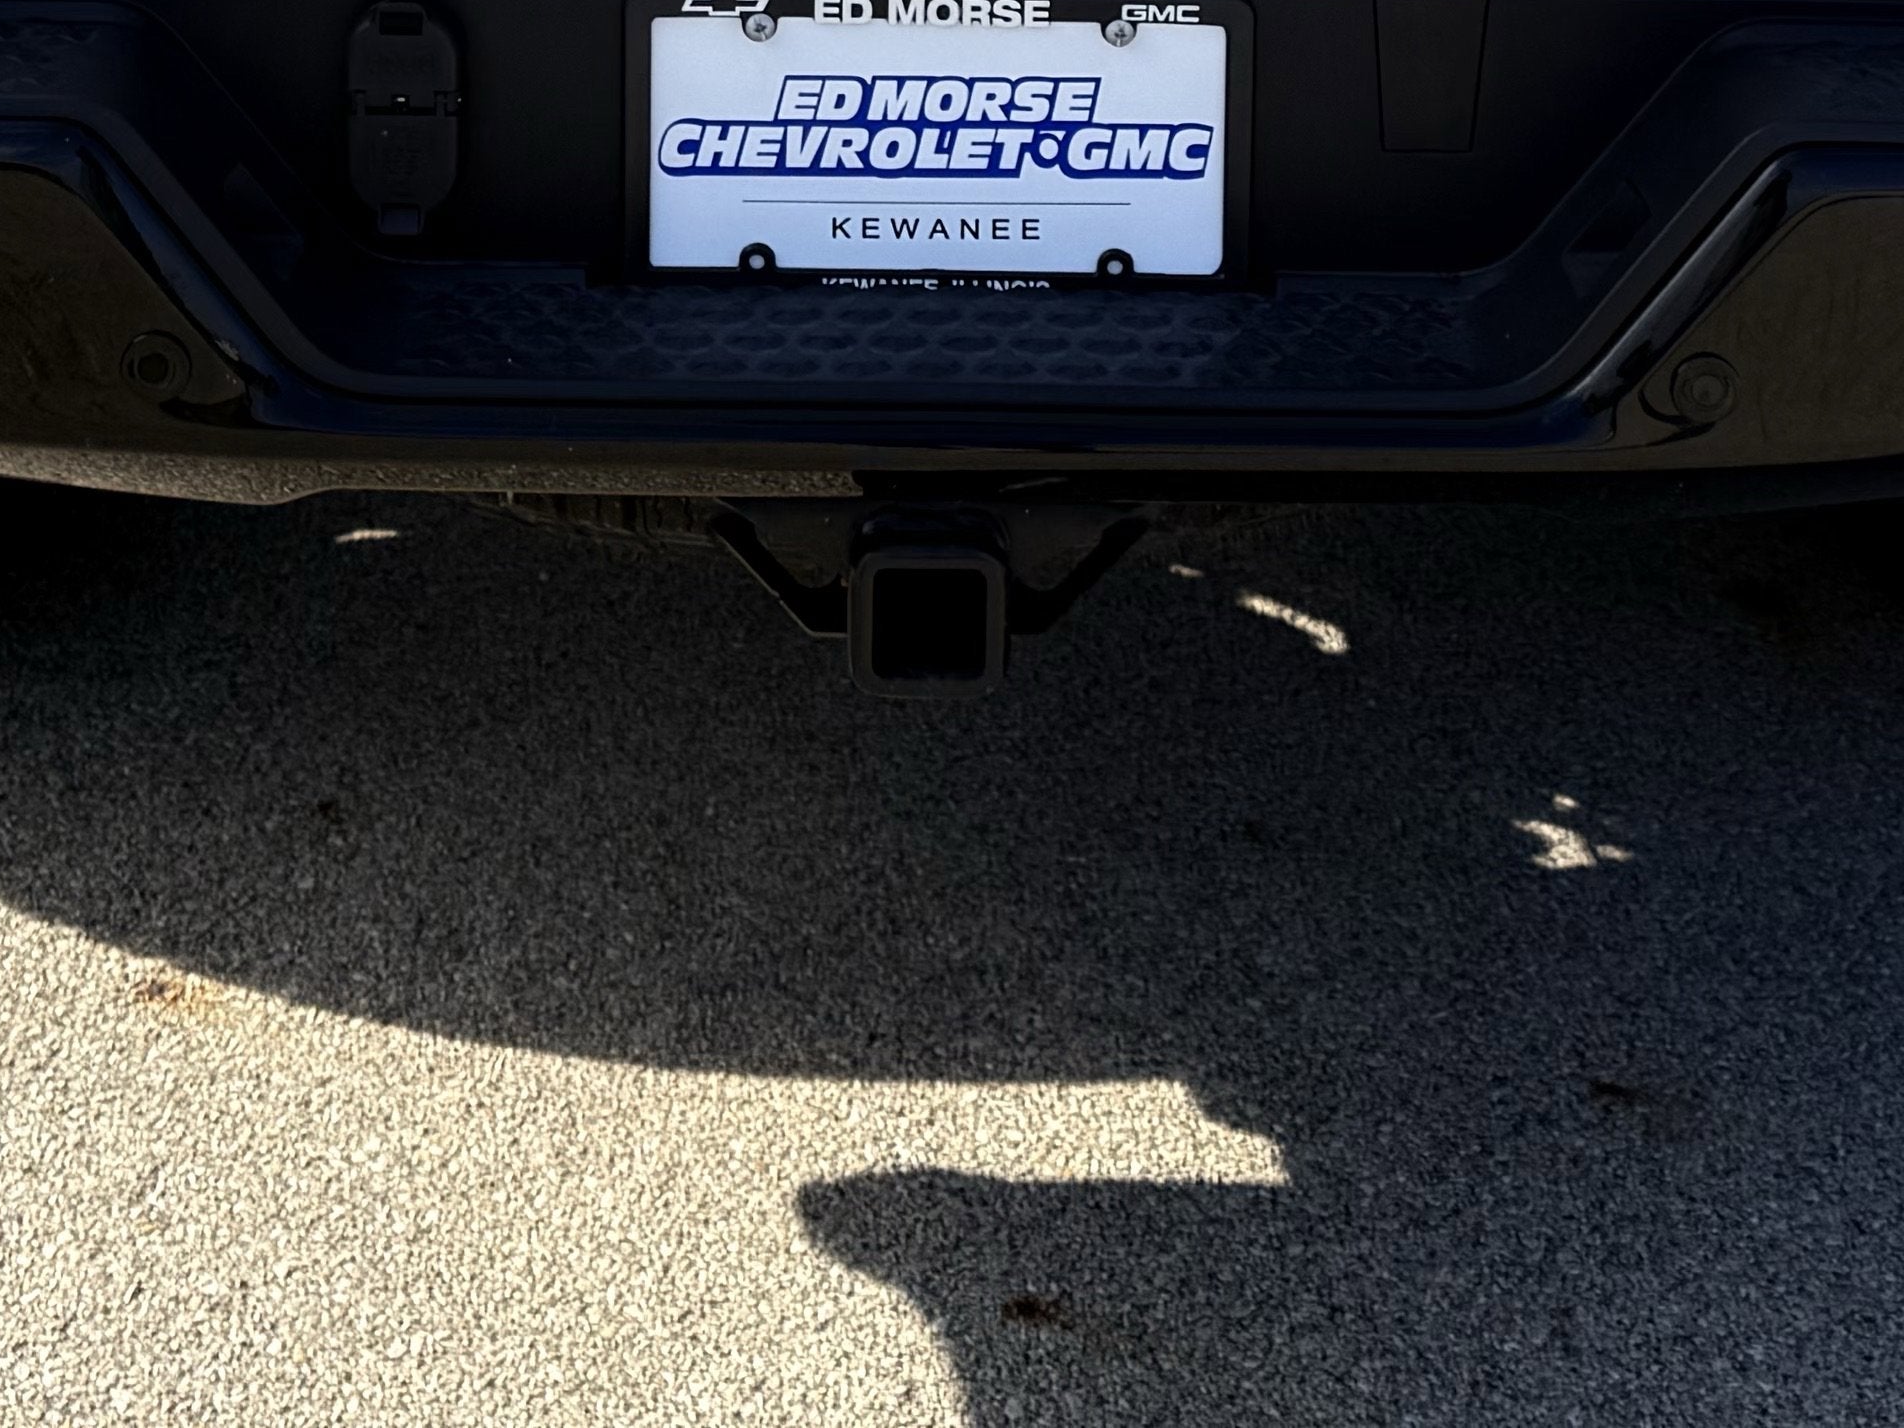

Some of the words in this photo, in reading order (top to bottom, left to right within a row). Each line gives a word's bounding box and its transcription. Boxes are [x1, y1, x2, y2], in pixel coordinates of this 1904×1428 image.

[1120, 3, 1201, 23] GMC
[776, 78, 864, 121] ED
[866, 78, 1097, 123] MORSE
[831, 216, 1042, 241] KEWANEE
